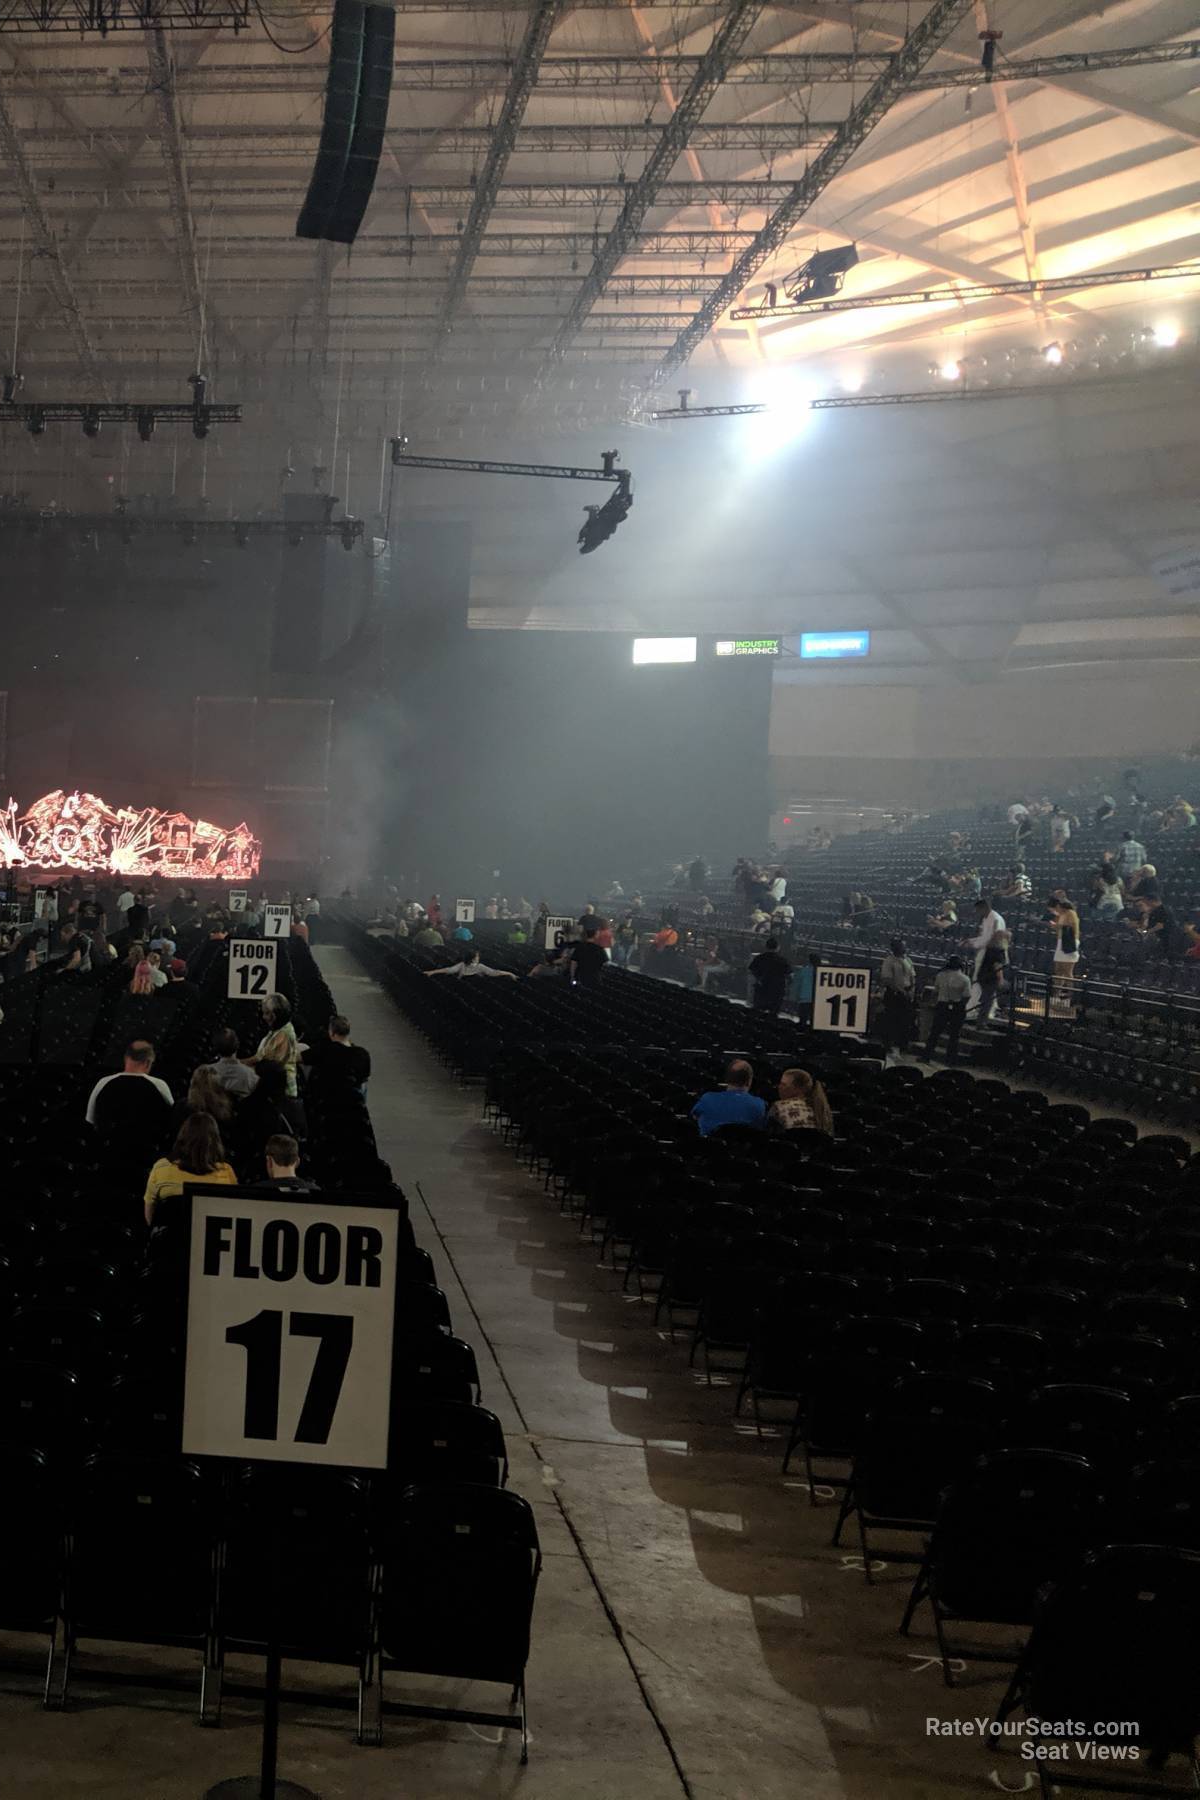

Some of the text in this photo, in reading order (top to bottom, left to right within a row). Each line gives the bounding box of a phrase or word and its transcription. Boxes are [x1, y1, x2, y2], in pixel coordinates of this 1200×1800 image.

[735, 640, 778, 648] INDUSTRY
[735, 647, 779, 655] GRAPHICS
[234, 898, 242, 910] 2
[266, 906, 289, 915] FLOOR
[462, 908, 468, 920] 1
[273, 918, 283, 935] 7
[553, 930, 565, 948] 6
[232, 943, 274, 959] FLOOR
[236, 964, 269, 995] 12
[820, 971, 866, 989] FLOOR
[825, 994, 857, 1027] 11
[203, 1215, 383, 1288] FLOOR
[225, 1309, 354, 1445] 17
